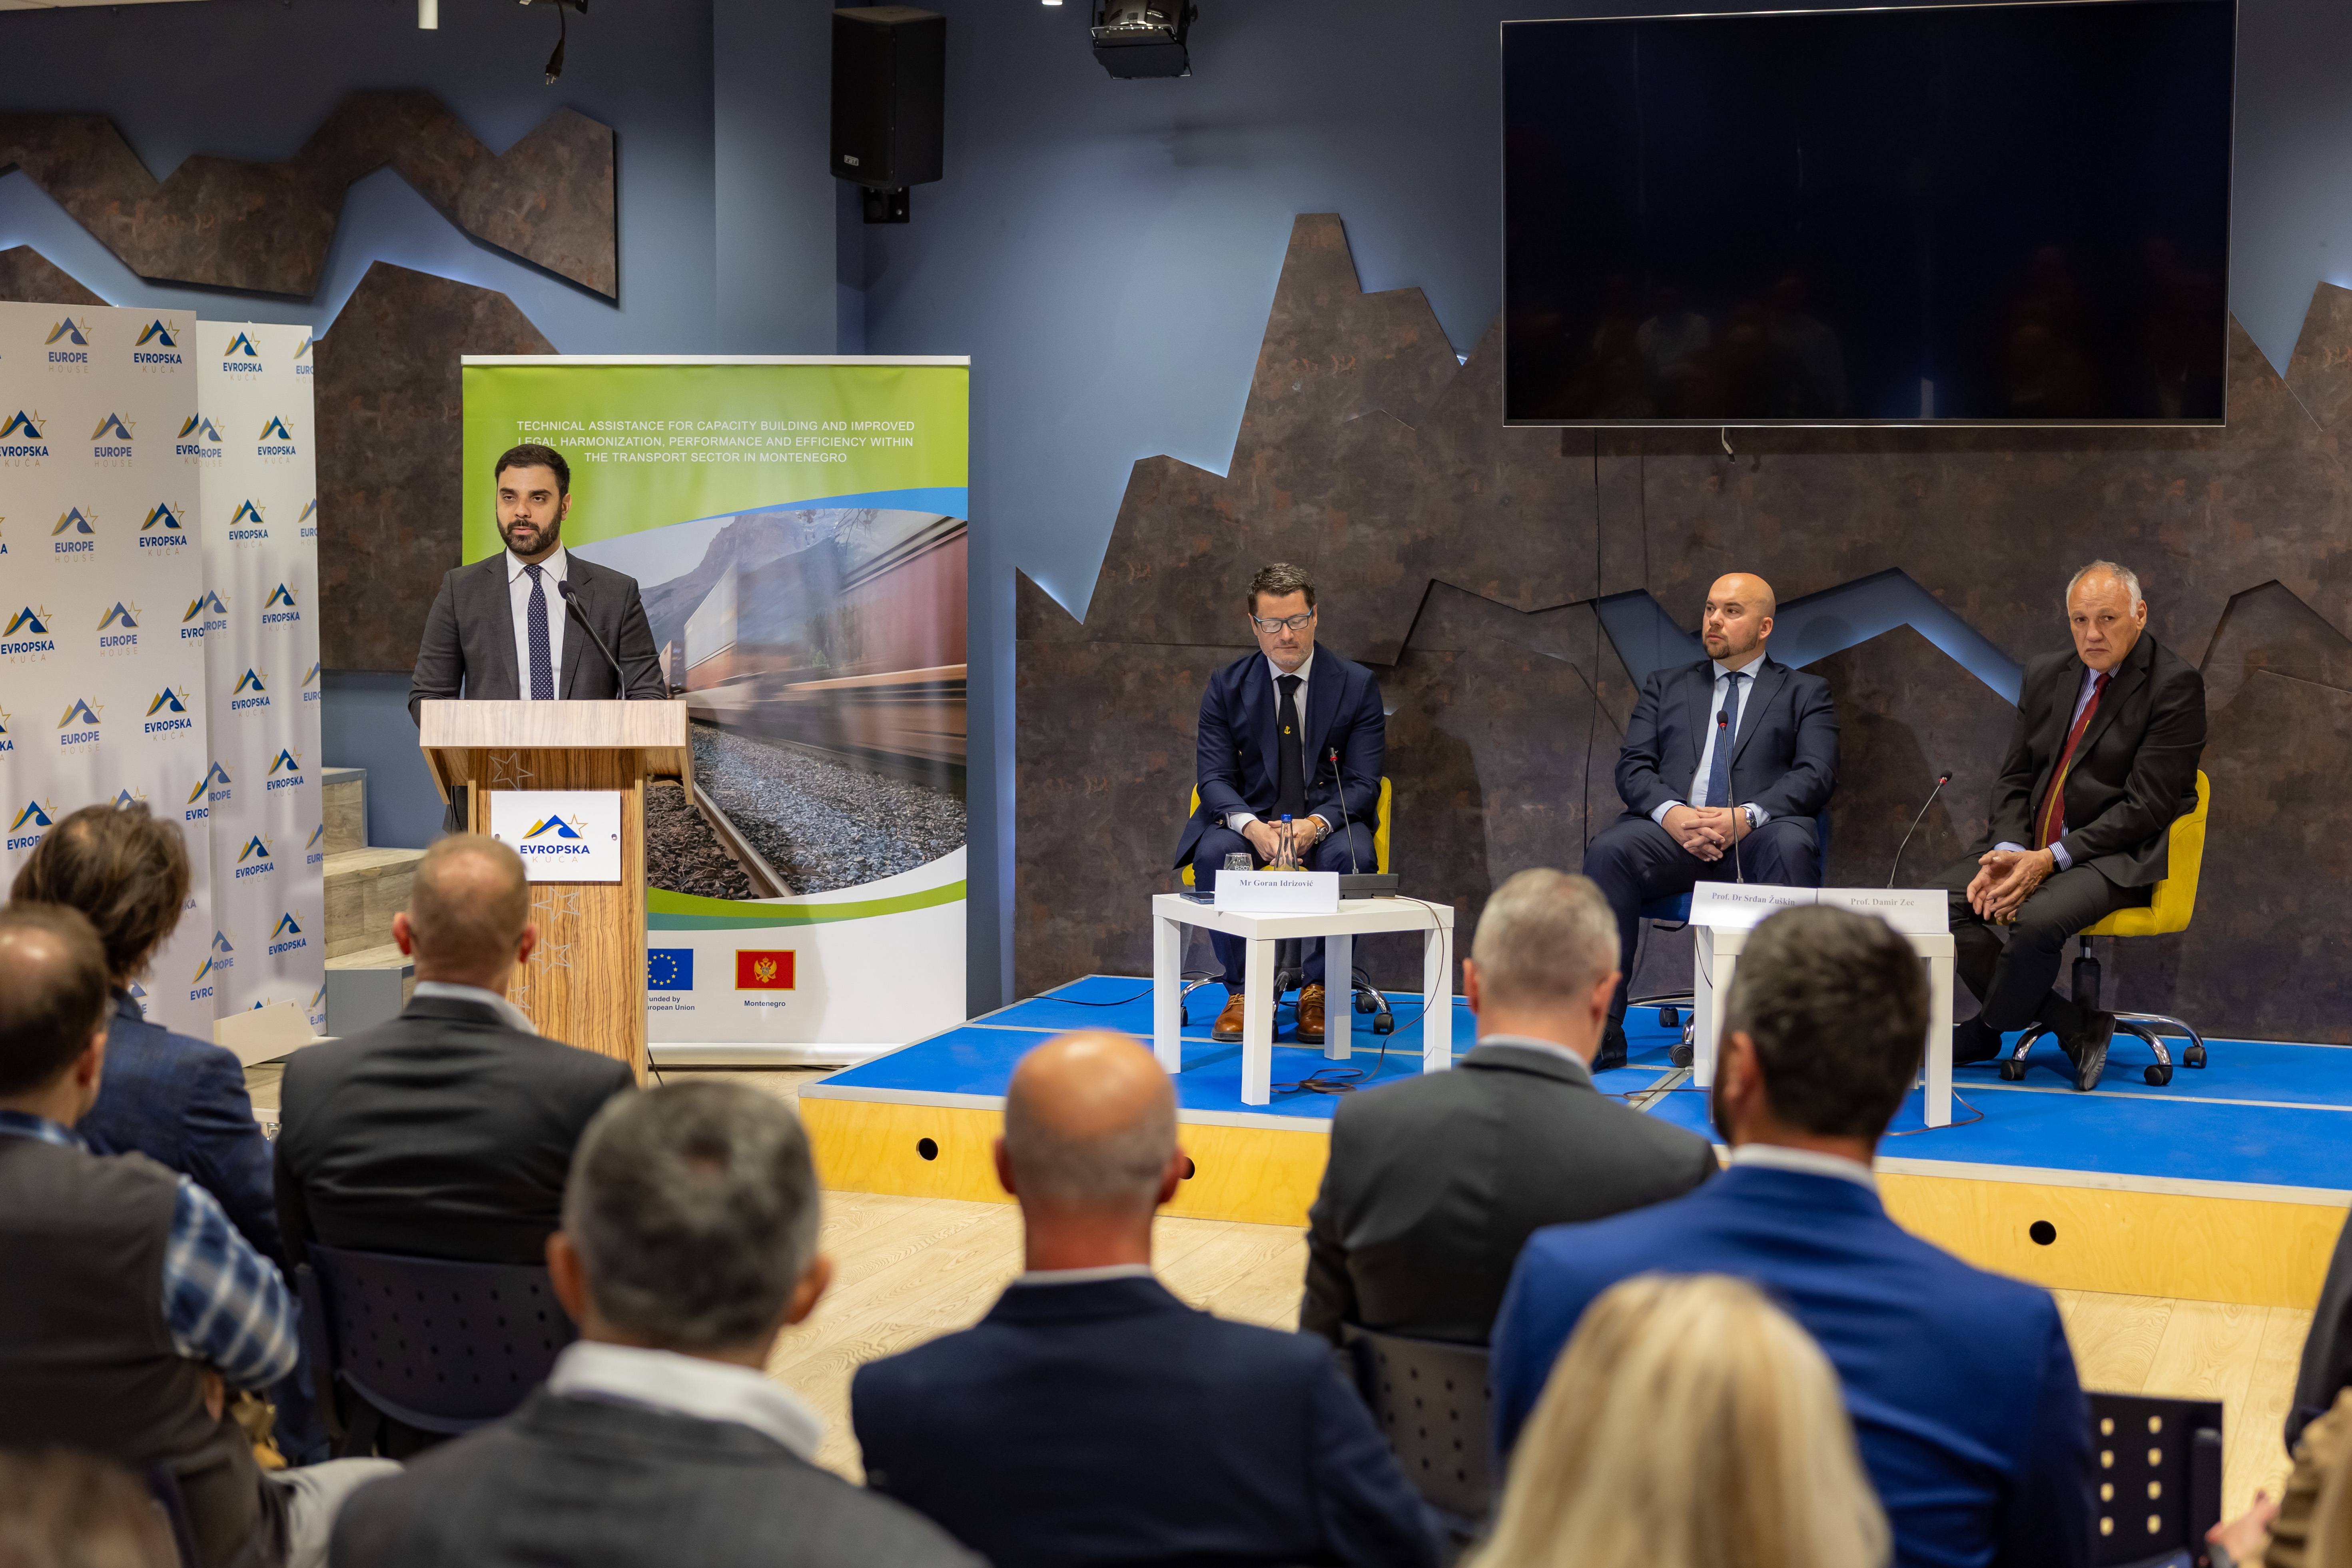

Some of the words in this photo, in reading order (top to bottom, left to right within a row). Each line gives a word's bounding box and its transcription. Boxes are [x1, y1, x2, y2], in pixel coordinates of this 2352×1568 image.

[49, 352, 88, 363] EUROPE
[134, 353, 182, 364] EVROPSKA
[143, 365, 174, 373] KUĆA
[223, 363, 262, 372] EVROPSKA
[517, 421, 585, 431] TECHNICAL
[588, 421, 664, 431] ASSISTANCE
[668, 421, 693, 431] FOR
[697, 421, 756, 431] CAPACITY
[761, 421, 818, 431] BUILDING
[822, 421, 847, 431] AND
[852, 421, 914, 431] IMPROVED
[561, 437, 665, 448] HARMONIZATION,
[670, 437, 762, 447] PERFORMANCE
[766, 437, 791, 447] AND
[796, 437, 866, 447] EFFICIENCY
[870, 437, 913, 447] WITHIN
[0, 446, 49, 457] VROPSKA
[94, 447, 132, 457] EUROPE
[258, 446, 295, 455] EVROPSKA
[5, 458, 40, 467] KUĆA
[95, 459, 132, 467] HOUSE
[585, 453, 608, 462] THE
[612, 453, 686, 462] TRANSPORT
[691, 453, 740, 462] SECTOR
[744, 453, 755, 462] IN
[760, 453, 846, 462] MONTENEGRO
[229, 529, 268, 540] EVROPSKA
[140, 535, 187, 547] EVROPSKA
[236, 540, 262, 548] KUĆA
[55, 541, 94, 553] EUROPE
[148, 547, 179, 557] KUĆA
[55, 554, 94, 563] HOUSE
[263, 612, 300, 623] EVROPSKA
[269, 623, 293, 632] KUĆA
[100, 634, 137, 647] EUROPE
[1, 640, 55, 654] EVROPSKA
[100, 647, 138, 657] HOUSE
[10, 653, 46, 664] KUĆA
[232, 696, 270, 710] EVROPSKA
[239, 708, 264, 718] KUĆA
[145, 718, 192, 733] EVROPSKA
[61, 731, 100, 745] EUROPE
[153, 730, 184, 741] KUĆA
[61, 744, 100, 755] HOUSE
[267, 776, 304, 790] EVROPSKA
[209, 790, 231, 802] ROPE
[8, 834, 46, 850] EVROP
[520, 845, 590, 854] EVROPSKA
[236, 862, 274, 878] EVROPSKA
[1769, 895, 1795, 906] Žuškin
[269, 938, 306, 955] EVROPSKA
[212, 958, 233, 971] ROPE
